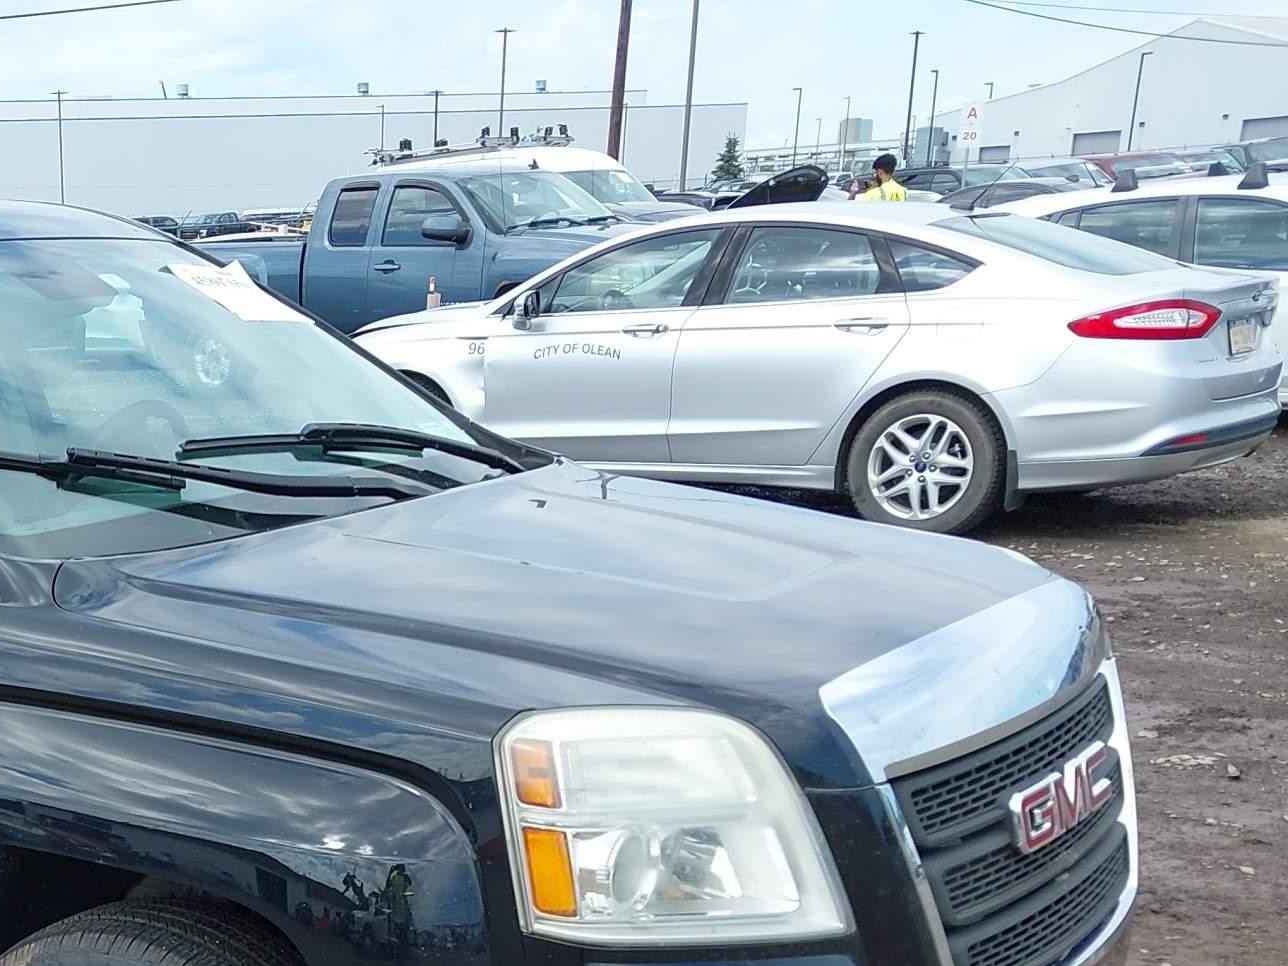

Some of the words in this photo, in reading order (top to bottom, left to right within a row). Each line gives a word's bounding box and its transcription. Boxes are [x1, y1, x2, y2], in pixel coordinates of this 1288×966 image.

[967, 107, 978, 119] A
[962, 131, 977, 141] 20
[468, 342, 486, 355] 96
[533, 344, 561, 360] CITY
[562, 343, 580, 354] OF
[581, 343, 621, 361] OLEAN
[1009, 740, 1114, 855] GMC
